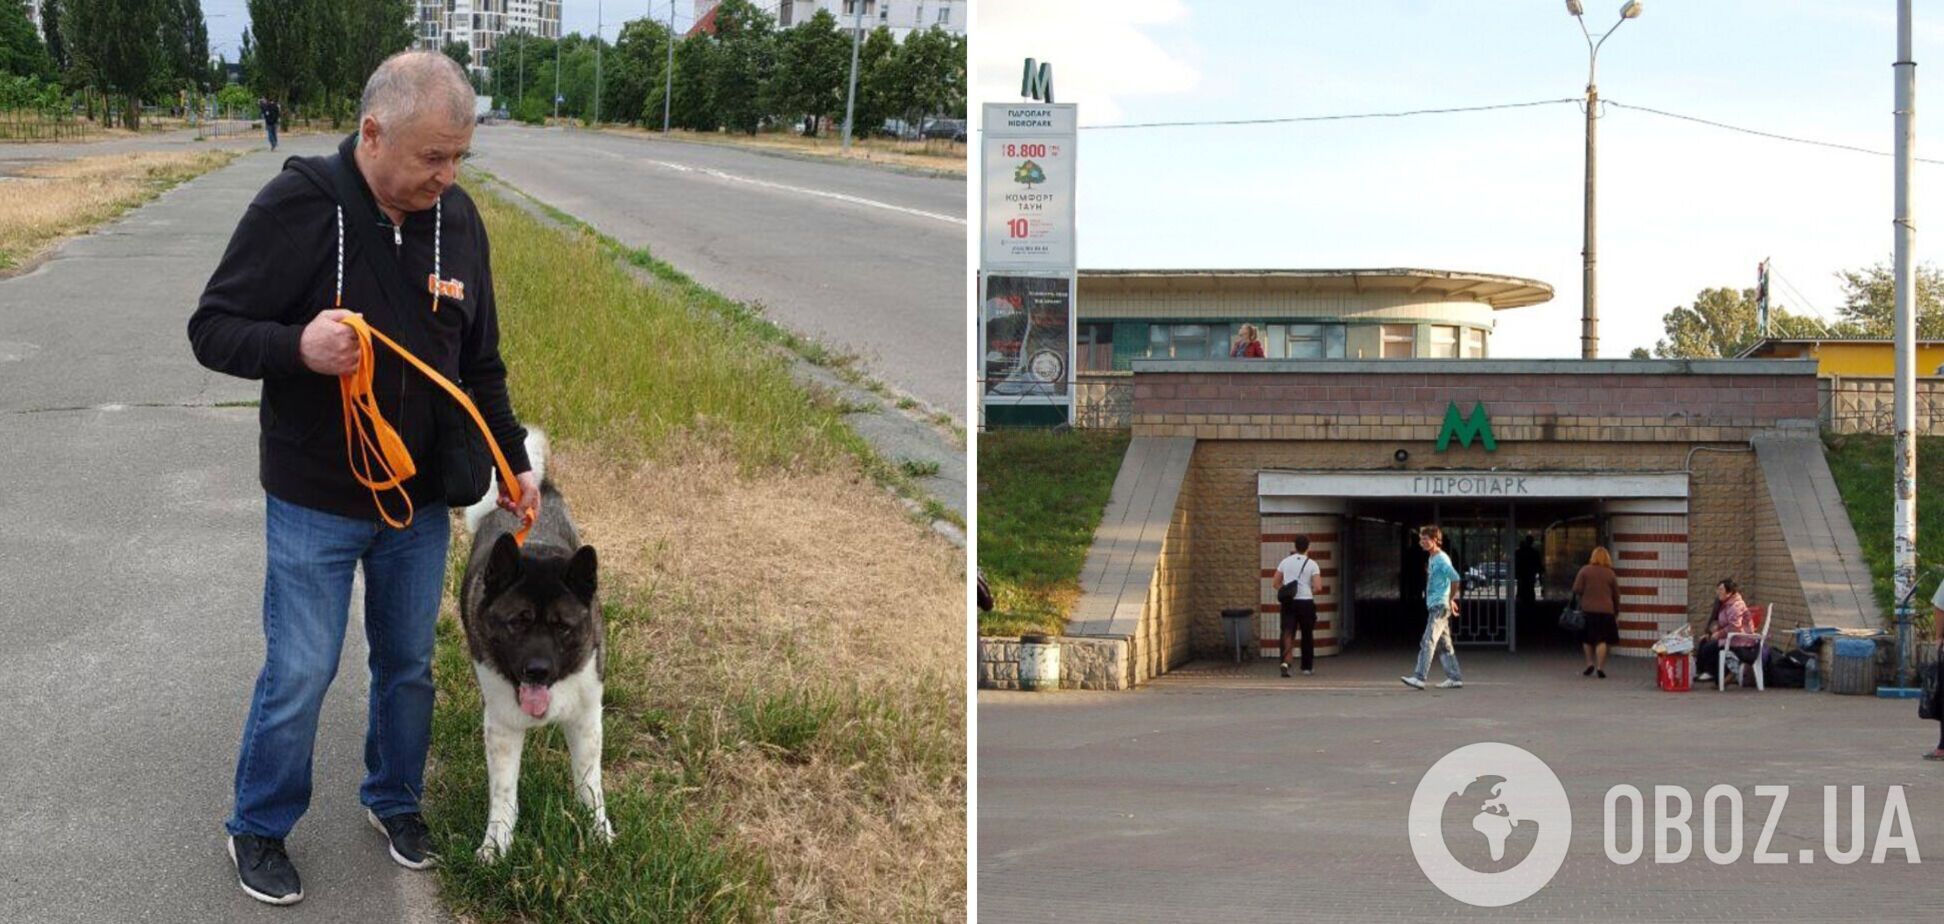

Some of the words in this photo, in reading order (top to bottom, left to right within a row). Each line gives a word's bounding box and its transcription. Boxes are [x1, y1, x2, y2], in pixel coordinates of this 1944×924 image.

[1007, 144, 1046, 158] 8.800
[1007, 218, 1028, 238] 10
[1413, 476, 1528, 495] ГІДРОПАРК
